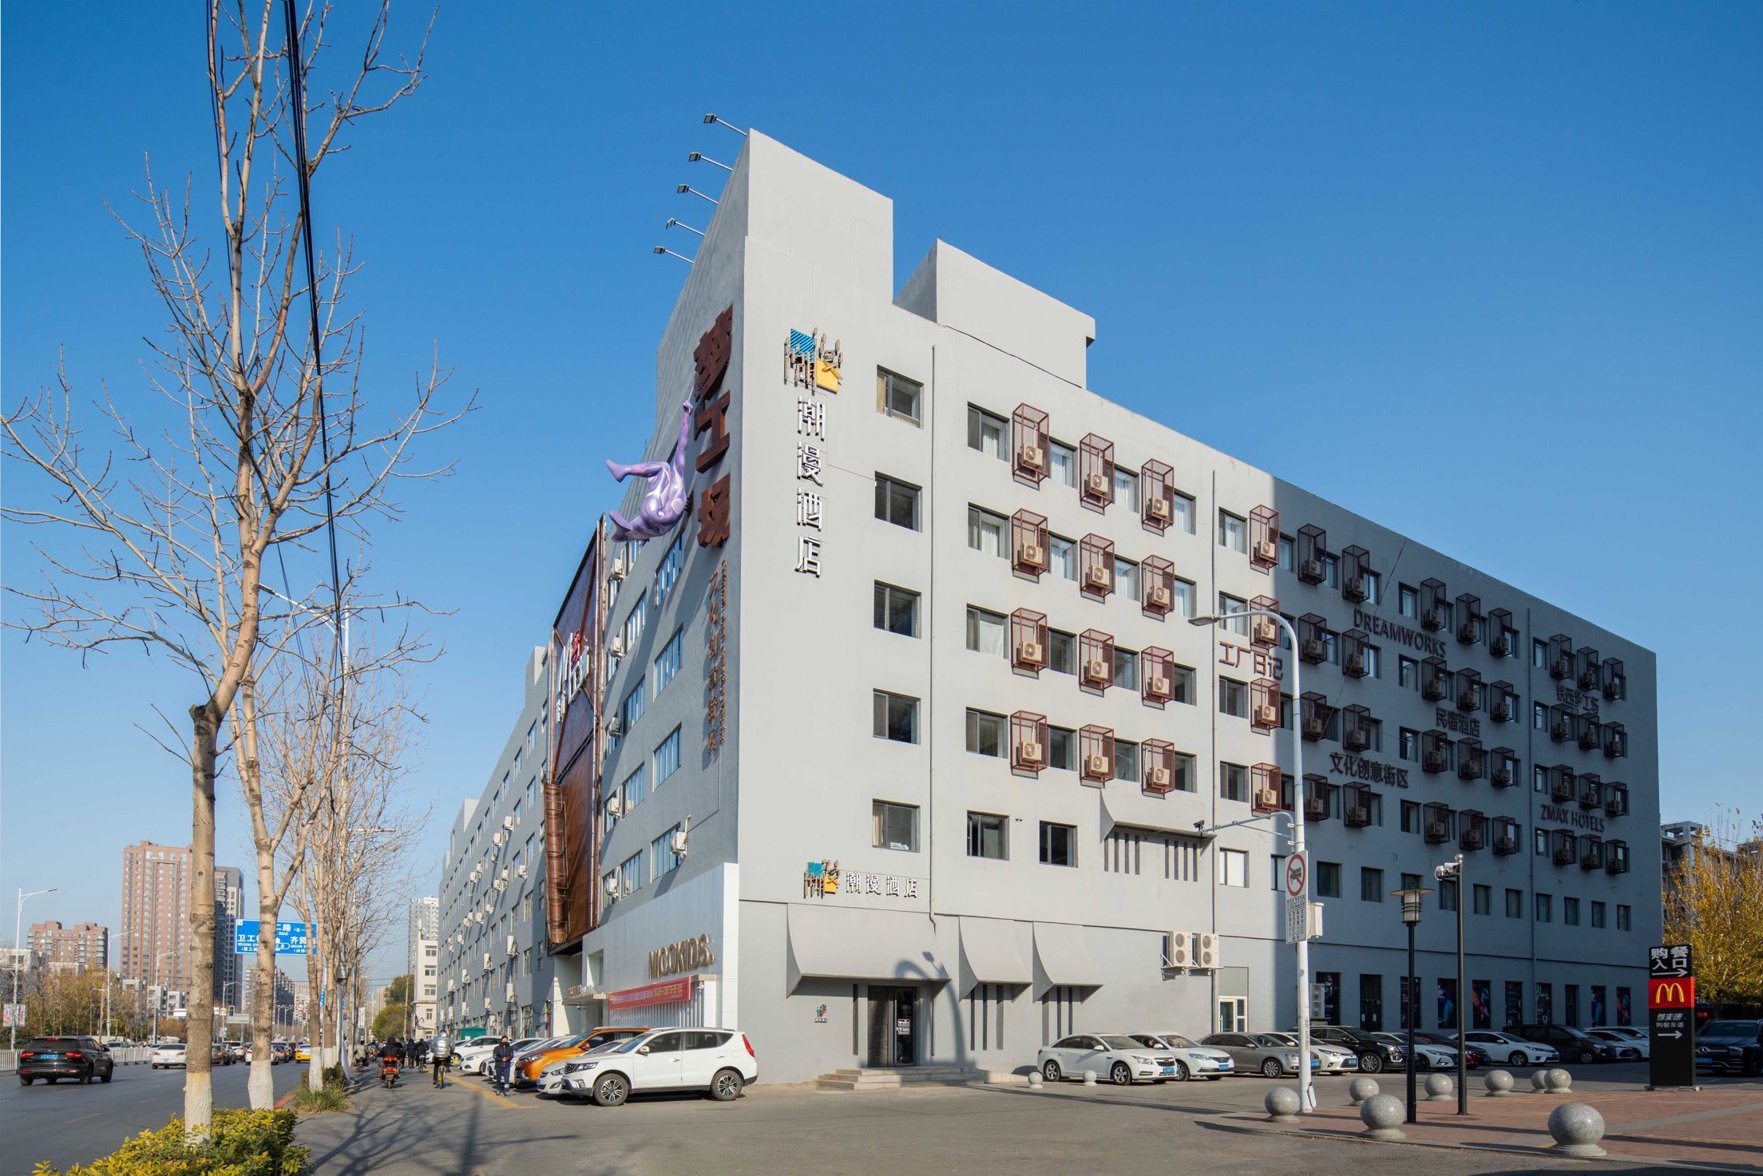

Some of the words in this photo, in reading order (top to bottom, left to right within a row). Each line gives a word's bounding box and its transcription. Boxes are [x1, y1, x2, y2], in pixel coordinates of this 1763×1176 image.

[795, 395, 826, 578] 潮漫酒店
[1354, 608, 1446, 658] DREAMWORKS
[1219, 641, 1284, 681] 工厂日记
[1329, 752, 1409, 788] 文化创意街区
[1540, 804, 1568, 824] ZMAX
[1571, 811, 1605, 833] HOTELS
[1651, 946, 1689, 959] 购餐
[1653, 958, 1687, 970] 入口
